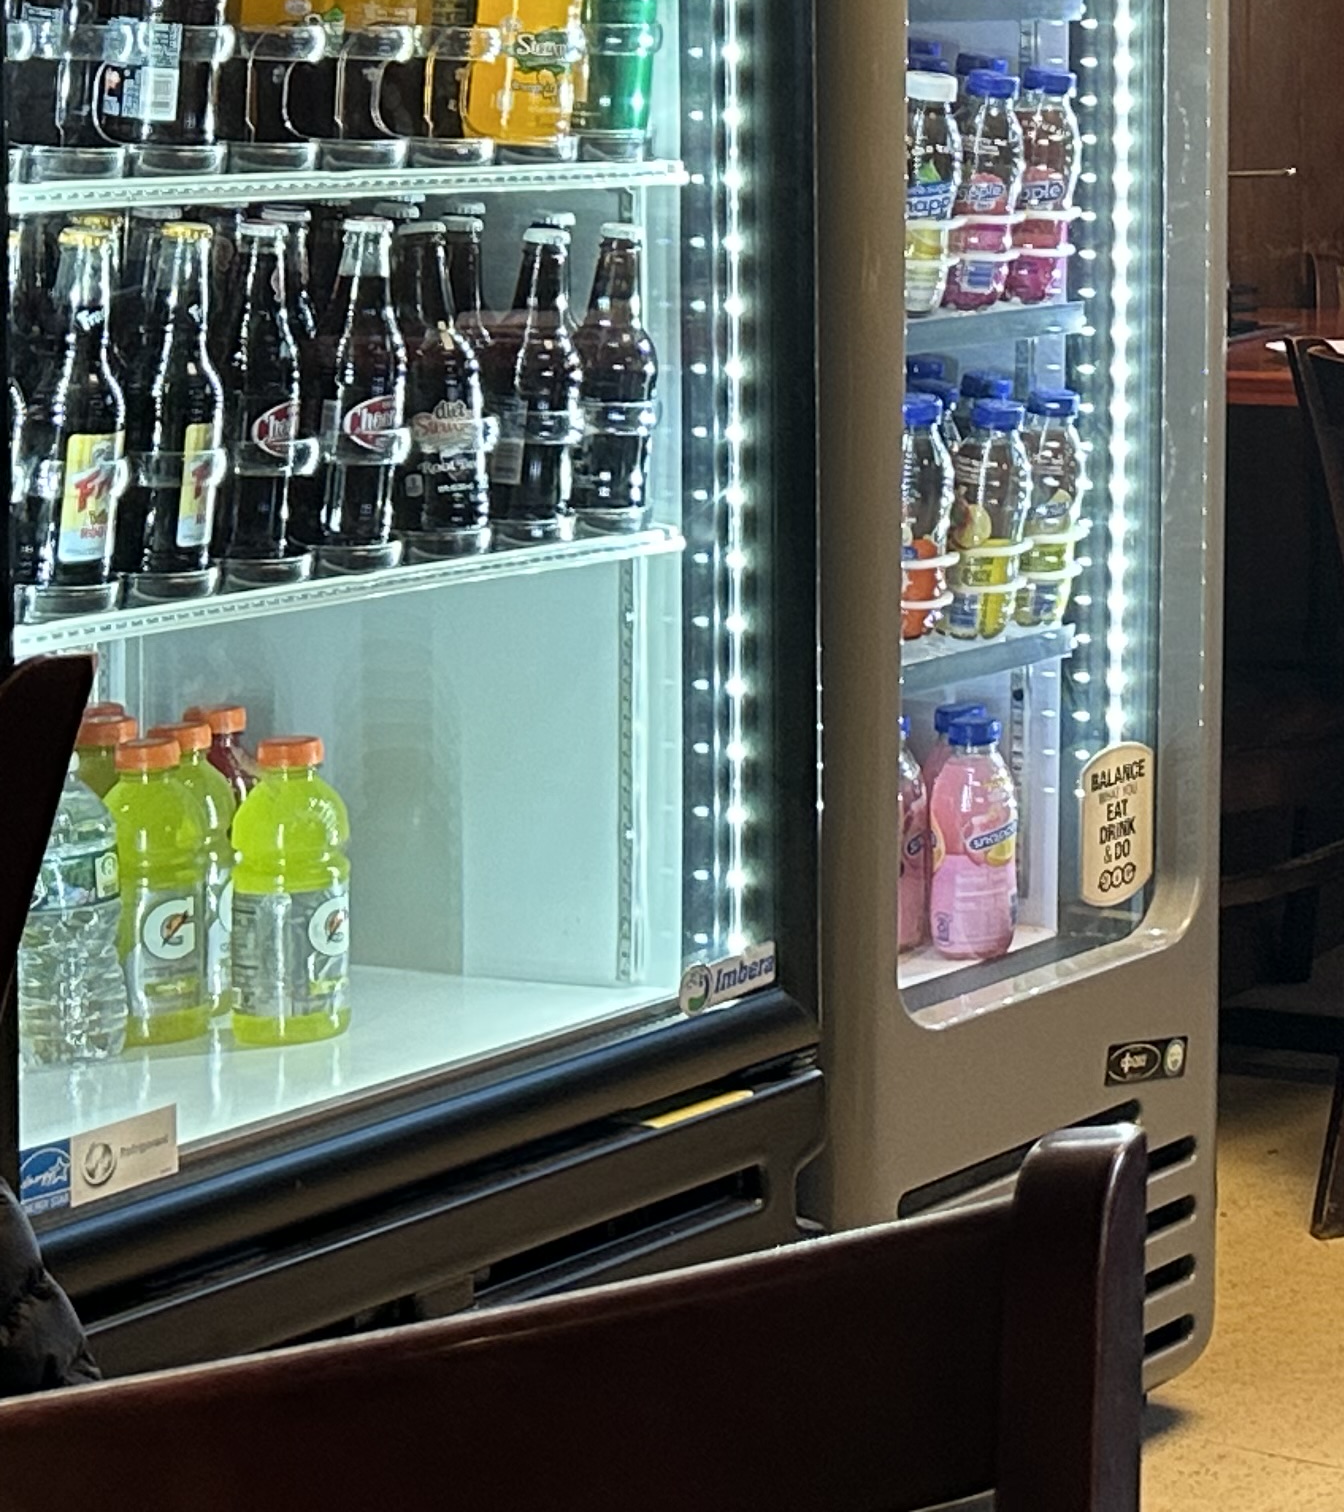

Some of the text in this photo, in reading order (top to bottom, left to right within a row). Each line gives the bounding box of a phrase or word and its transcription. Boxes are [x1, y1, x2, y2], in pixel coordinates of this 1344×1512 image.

[906, 196, 951, 220] napp
[1091, 758, 1146, 793] BALANCE
[1106, 798, 1129, 822] EAT
[1099, 816, 1137, 846] DRINK
[1104, 838, 1131, 864] & DO
[714, 955, 775, 993] Imbera
